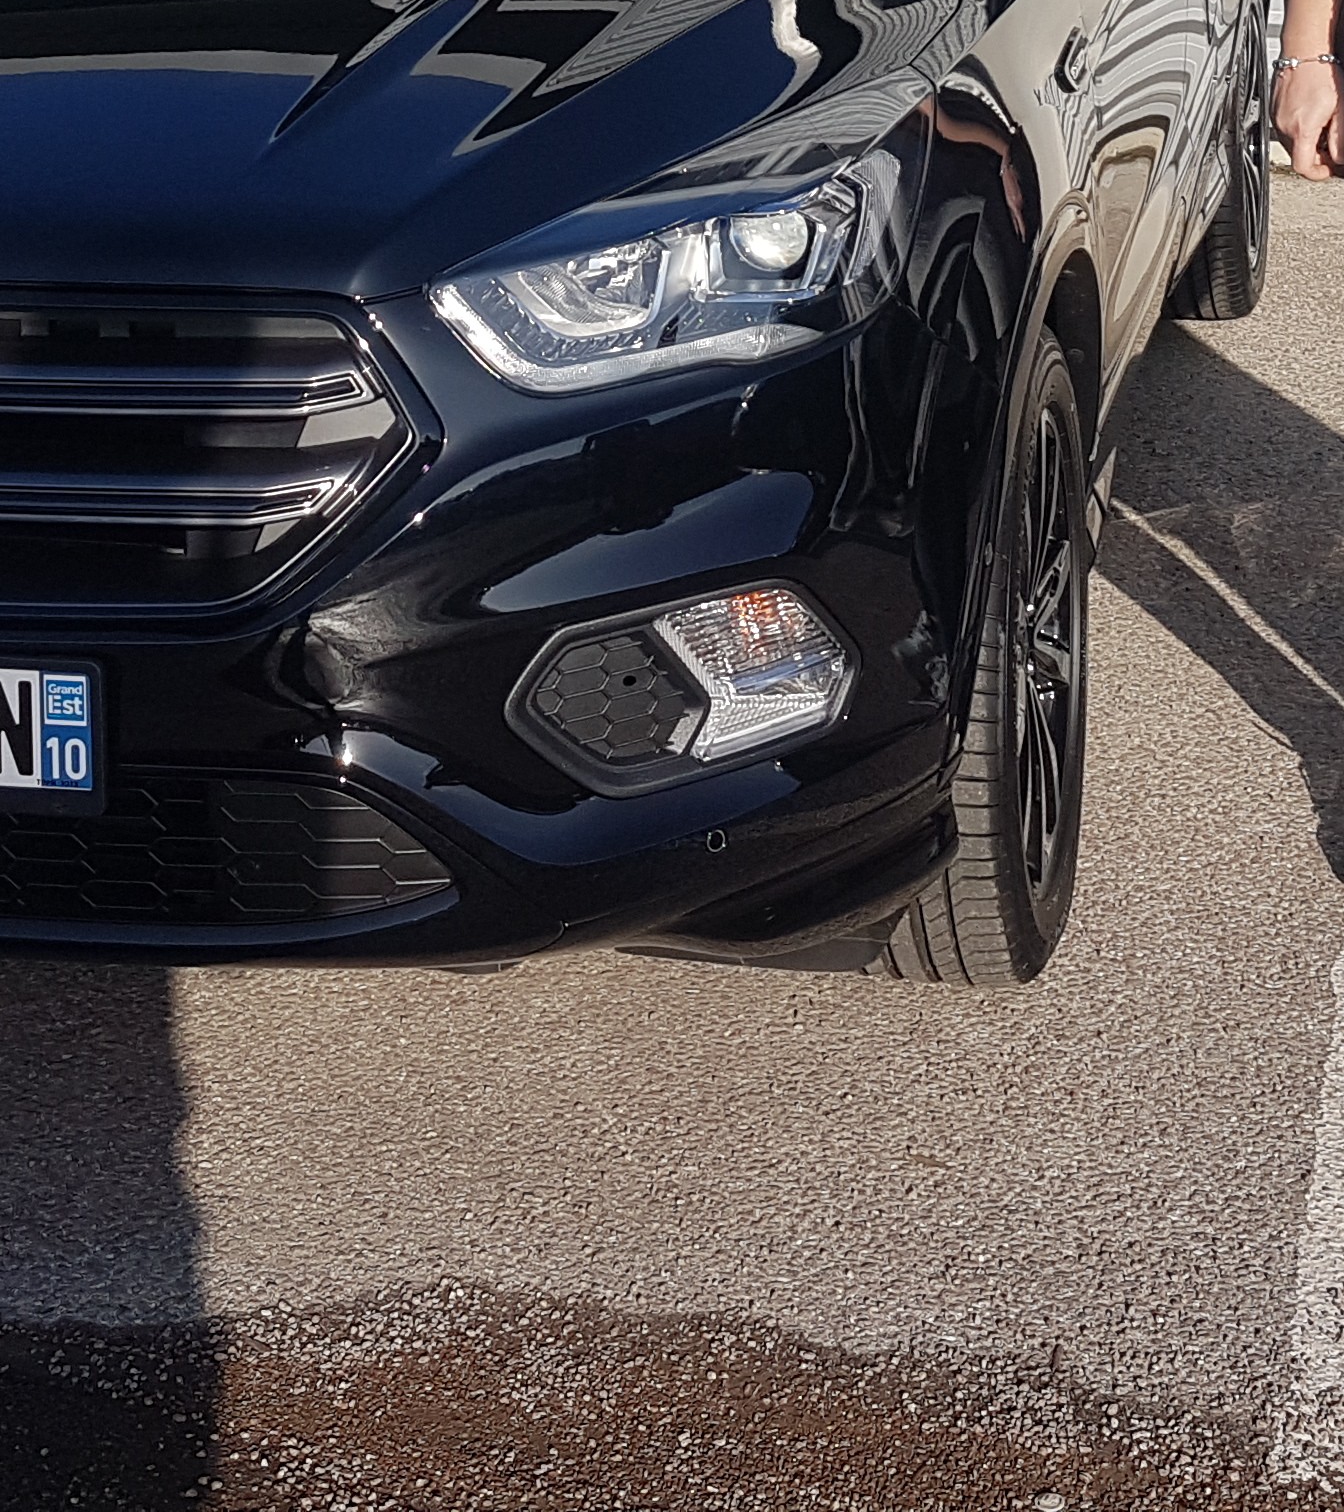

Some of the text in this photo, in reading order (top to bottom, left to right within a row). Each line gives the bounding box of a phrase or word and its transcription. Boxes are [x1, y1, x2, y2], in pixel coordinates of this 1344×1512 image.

[47, 683, 83, 695] Grand
[47, 694, 83, 716] Est
[45, 736, 87, 781] 10
